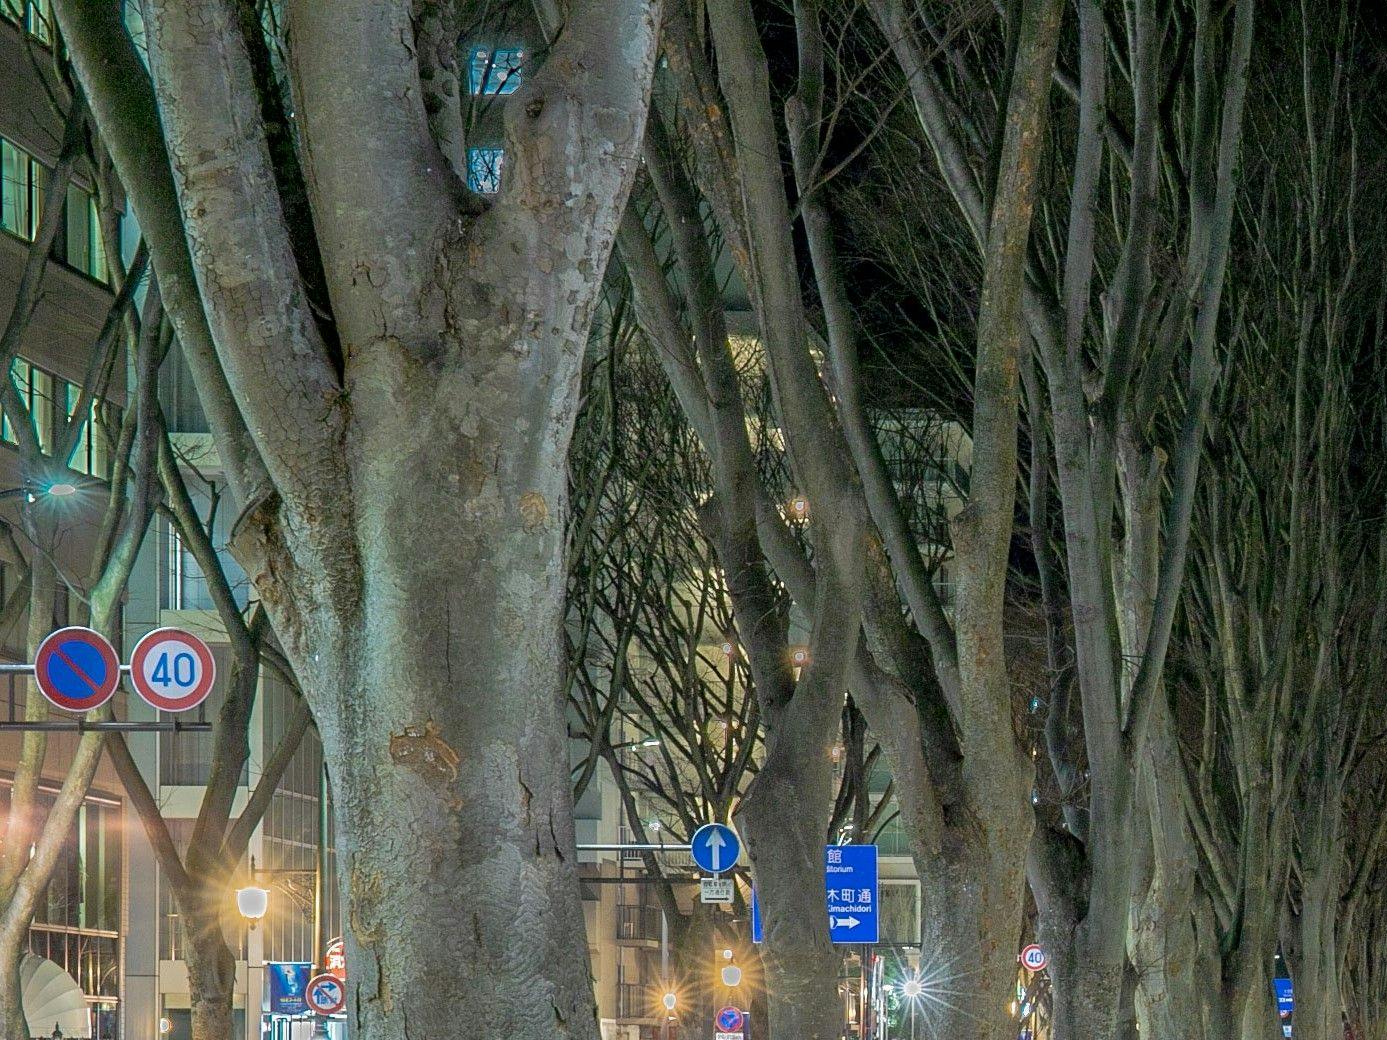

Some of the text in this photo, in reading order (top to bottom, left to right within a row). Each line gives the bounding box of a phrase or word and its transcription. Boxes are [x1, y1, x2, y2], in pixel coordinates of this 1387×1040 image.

[152, 652, 195, 688] 40
[827, 849, 842, 864] 館
[827, 888, 871, 903] 木町通
[1028, 952, 1042, 963] 40
